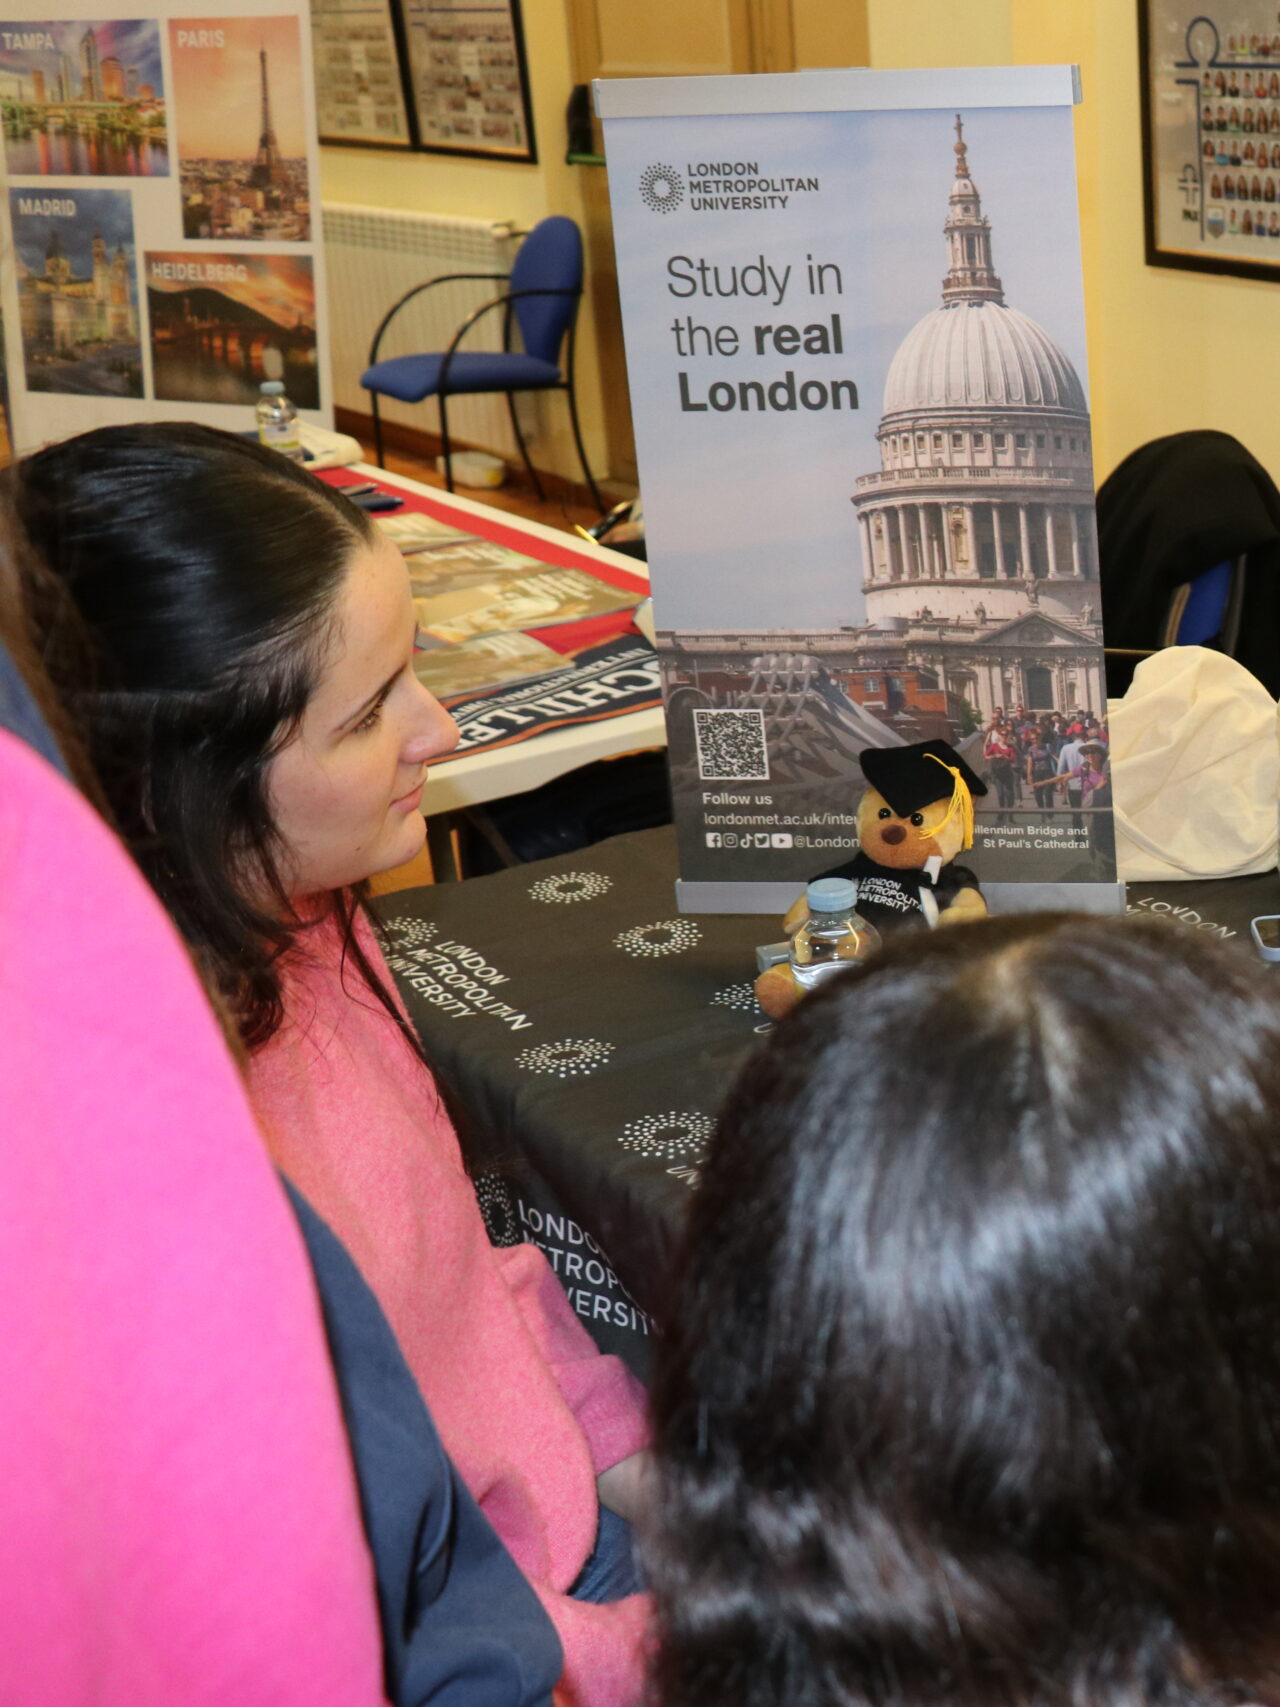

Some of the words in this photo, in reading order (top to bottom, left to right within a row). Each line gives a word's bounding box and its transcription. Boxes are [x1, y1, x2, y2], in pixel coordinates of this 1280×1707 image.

[1, 32, 55, 50] TAMPA
[177, 29, 225, 48] PARIS
[687, 162, 758, 178] LONDON
[688, 177, 820, 194] METROPOLITAN
[18, 198, 77, 217] MADRID
[690, 195, 790, 211] UNIVERSITY
[151, 262, 248, 282] HEIDELBERG
[666, 255, 791, 306] Study
[806, 253, 843, 295] in
[671, 316, 739, 356] the
[754, 314, 844, 356] real
[678, 371, 859, 412] London
[702, 792, 750, 805] Follow
[754, 794, 773, 805] us
[974, 825, 1024, 835] illennium
[1027, 826, 1064, 837] Bridge
[1067, 826, 1089, 836] and
[983, 839, 996, 848] St
[998, 839, 1031, 849] Paul's
[1034, 839, 1090, 849] Cathedral
[862, 877, 902, 890] LONDON
[1137, 897, 1237, 939] LONDON
[434, 941, 511, 985] LONDON
[406, 949, 533, 1031] METROPOLITAN
[518, 1199, 613, 1267] LONDO
